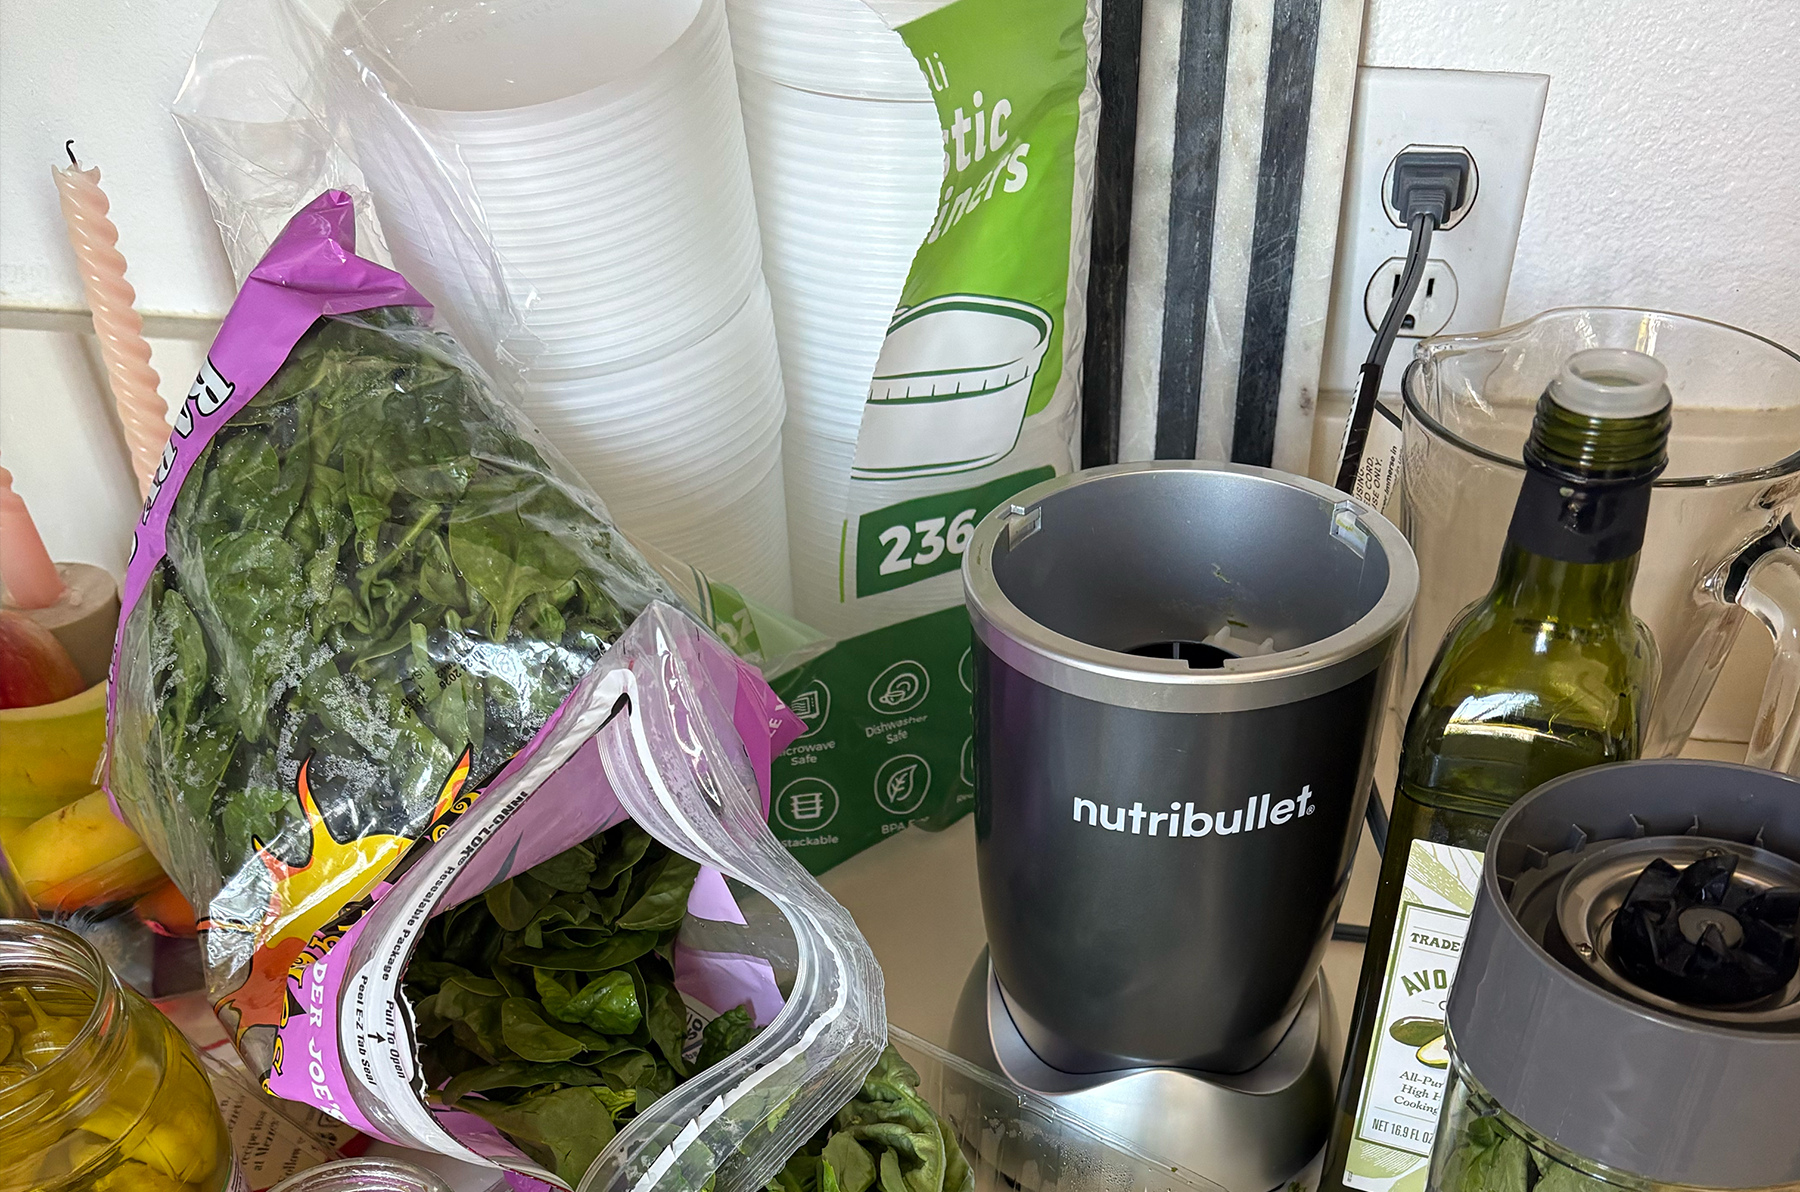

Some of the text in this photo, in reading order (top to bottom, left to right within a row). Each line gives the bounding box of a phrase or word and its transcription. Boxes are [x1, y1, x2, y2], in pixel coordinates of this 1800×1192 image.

[925, 52, 949, 92] li
[927, 143, 1030, 244] iners
[1374, 458, 1383, 489] ONLY.
[879, 508, 977, 576] 236
[865, 715, 928, 738] Dishwasher
[886, 729, 909, 745] Safe
[790, 755, 818, 767] Safe
[881, 821, 906, 835] BPA
[407, 865, 456, 928] Resealable
[381, 928, 412, 981] Package
[1411, 932, 1460, 953] TRADE
[309, 961, 328, 1028] DER
[1401, 969, 1447, 997] AVO
[355, 975, 378, 1086] Peel E-Z Tab Seal
[385, 1000, 406, 1079] Pull To Open
[1399, 1071, 1444, 1088] All-Pur
[1401, 1083, 1429, 1099] High
[1371, 1118, 1390, 1133] NET
[1391, 1123, 1409, 1139] 16.9
[1410, 1129, 1420, 1142] FL
